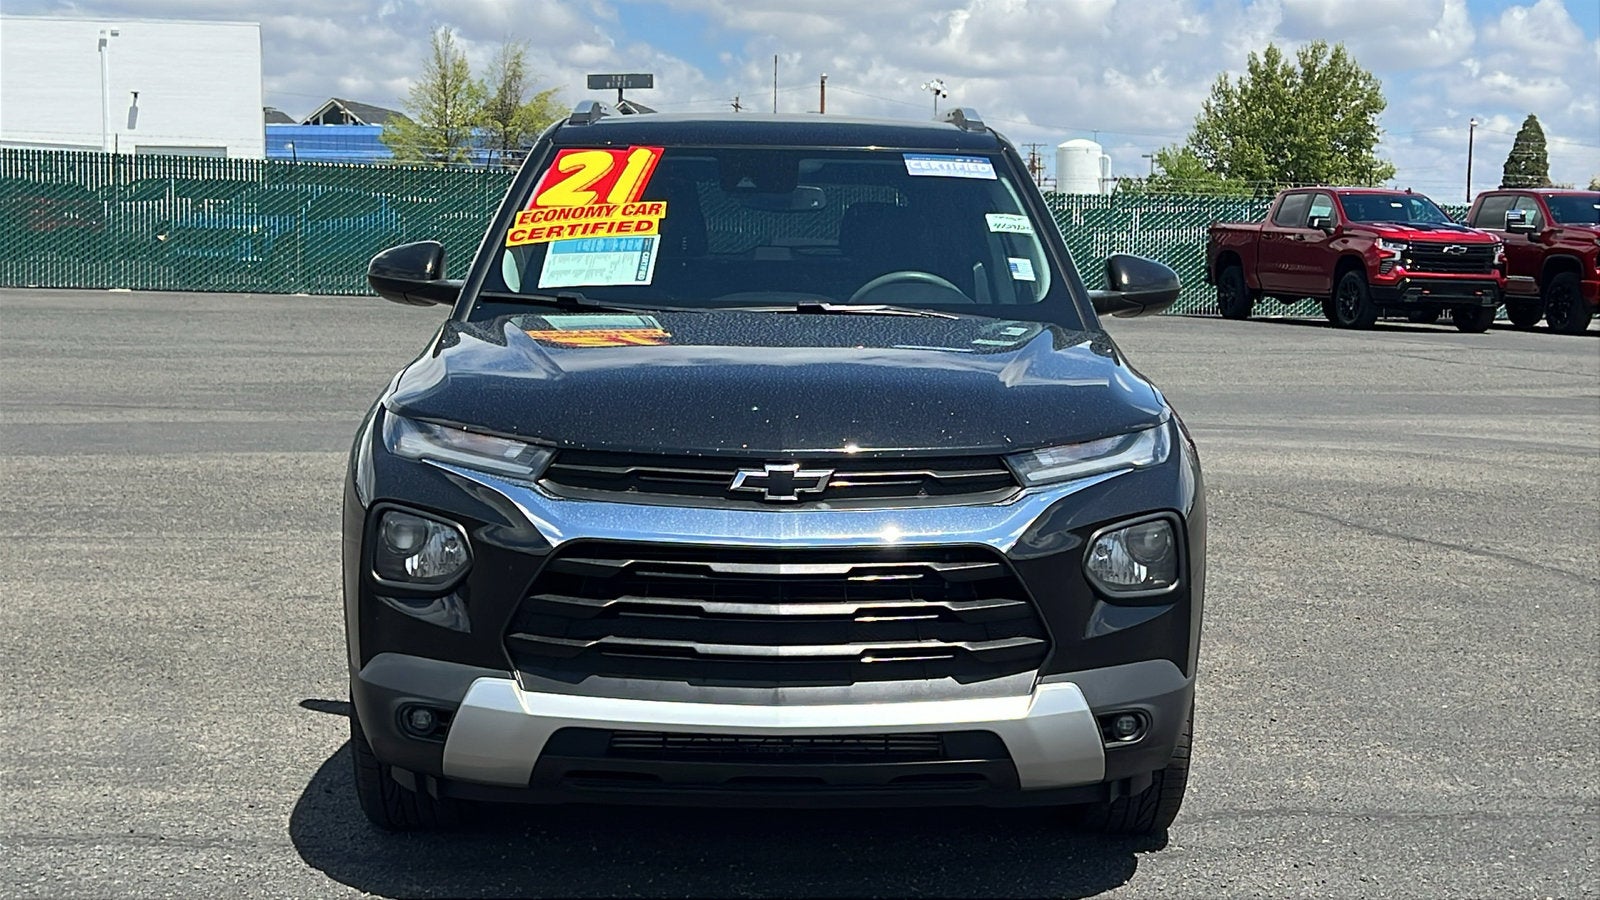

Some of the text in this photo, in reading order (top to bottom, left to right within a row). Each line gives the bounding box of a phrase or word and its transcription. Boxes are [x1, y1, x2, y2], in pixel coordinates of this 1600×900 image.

[536, 148, 655, 206] 21
[910, 161, 990, 173] CERTIFIED
[518, 203, 663, 224] ECONOMY CAR
[509, 220, 654, 243] CERTIFIED
